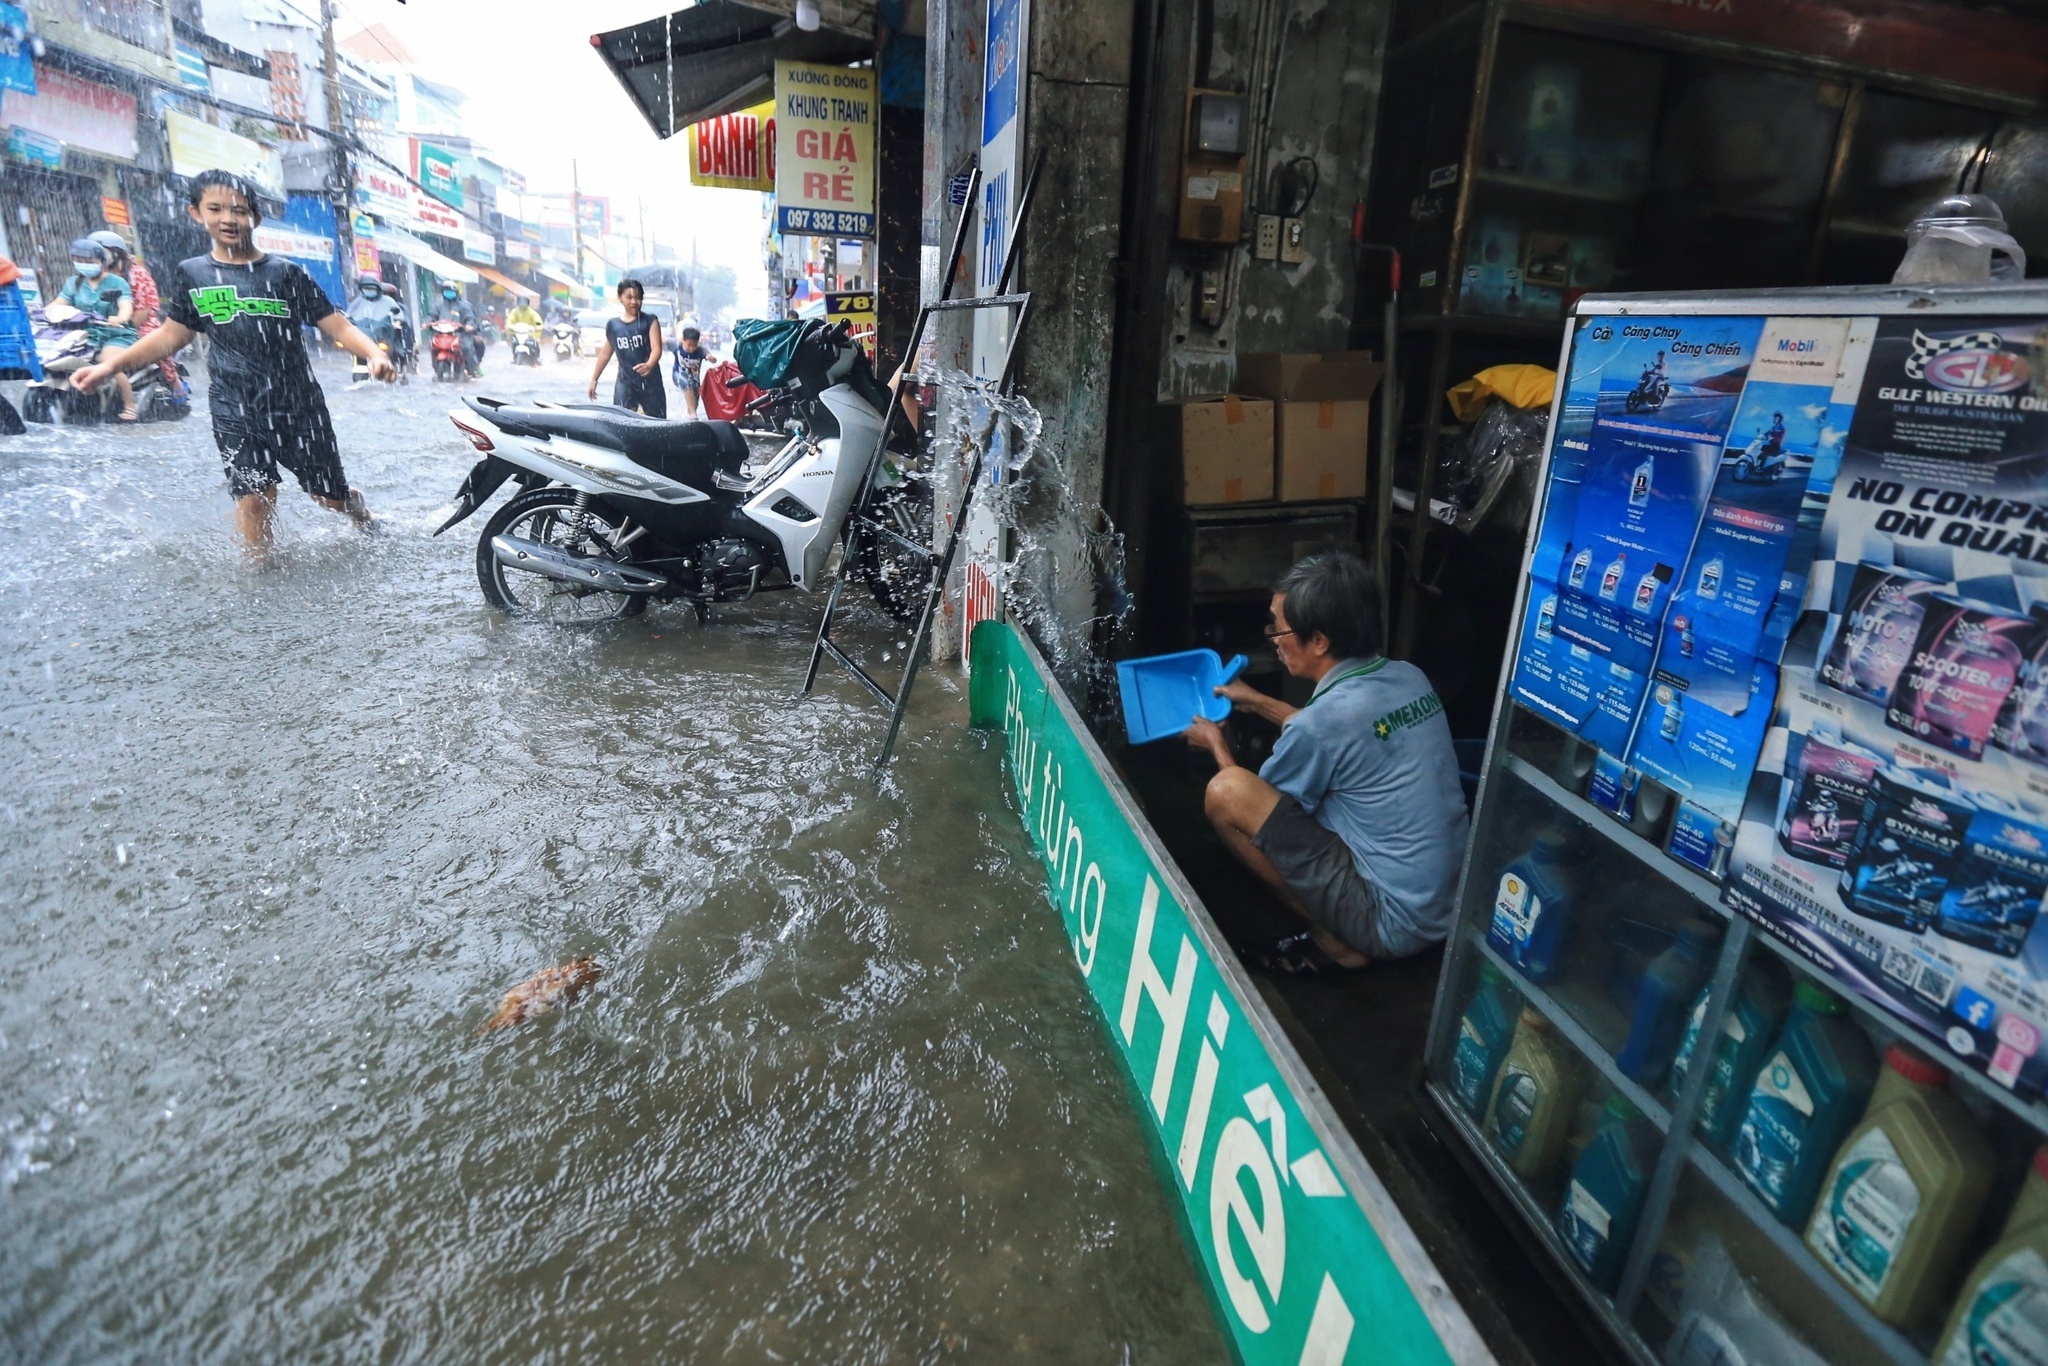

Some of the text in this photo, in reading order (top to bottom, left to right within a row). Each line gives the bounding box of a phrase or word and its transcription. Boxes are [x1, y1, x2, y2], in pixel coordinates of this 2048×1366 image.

[788, 94, 868, 123] KHUNG TRANH
[796, 127, 857, 163] GIÁ
[803, 165, 855, 203] RẺ
[787, 209, 868, 234] 097 332 5219
[836, 295, 875, 311] 78
[1622, 325, 1651, 340] Càng
[1653, 326, 1682, 341] Chạy
[1778, 339, 1815, 353] Mobil
[1671, 340, 1742, 357] Càng Chiến
[1878, 387, 2048, 412] GULF WESTERN OIL
[1892, 404, 2025, 424] THE TOUGH AUSTRALIAN
[802, 469, 834, 479] HONDA
[1847, 476, 1905, 505] NO
[1713, 508, 1784, 533] Dầu dành cho xe tay ga
[1874, 509, 1936, 540] ON
[1715, 527, 1731, 537] Mobil
[1732, 531, 1749, 541] Super
[1780, 579, 1792, 590] ga
[1849, 610, 1899, 640] MOTO
[1914, 652, 1992, 687] SCOOTER
[1908, 673, 1963, 703] 10W-40
[1814, 773, 1853, 794] SYN-M
[1885, 817, 1960, 850] SYN-M 4T
[1972, 842, 2030, 870] SYN-M
[1741, 872, 1761, 890] HIGH
[1761, 885, 1796, 911] QUALITY
[1818, 919, 1853, 946] ENGINE
[1854, 942, 1879, 962] OILS
[1003, 664, 1356, 1366] Phụ tùng Hiế
